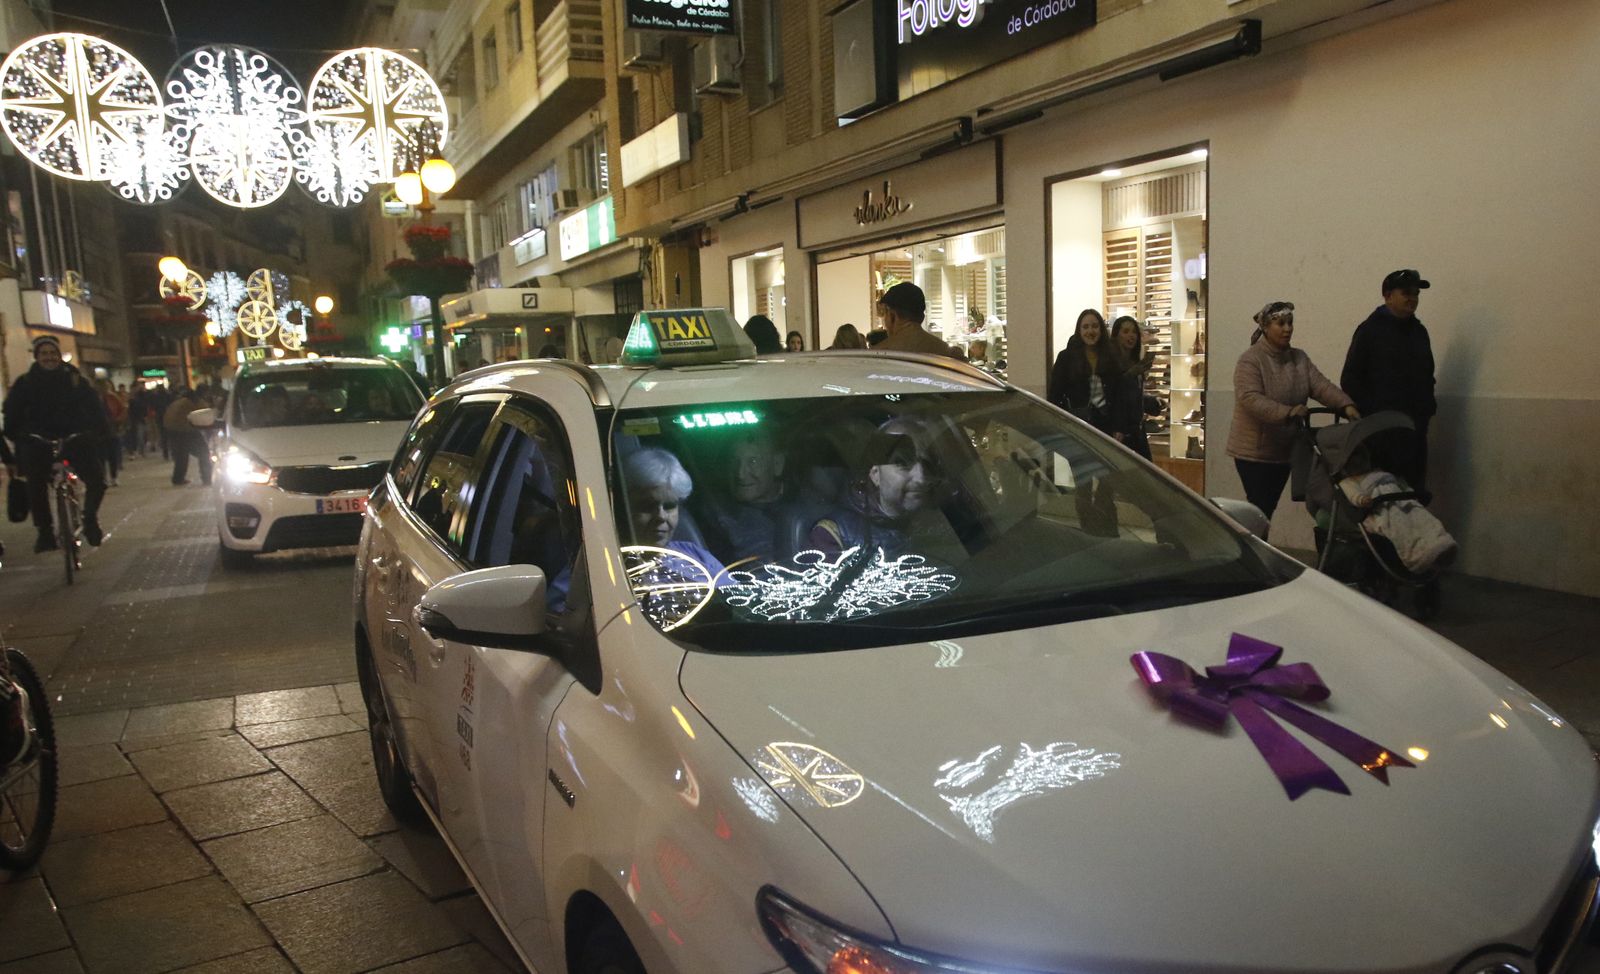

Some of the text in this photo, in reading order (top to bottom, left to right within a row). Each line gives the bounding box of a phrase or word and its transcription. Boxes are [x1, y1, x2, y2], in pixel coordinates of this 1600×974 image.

[687, 7, 697, 15] de
[1007, 0, 1076, 34] de Córdoba
[650, 315, 711, 340] TAXI
[245, 349, 265, 360] TAXI
[326, 500, 360, 512] 3416
